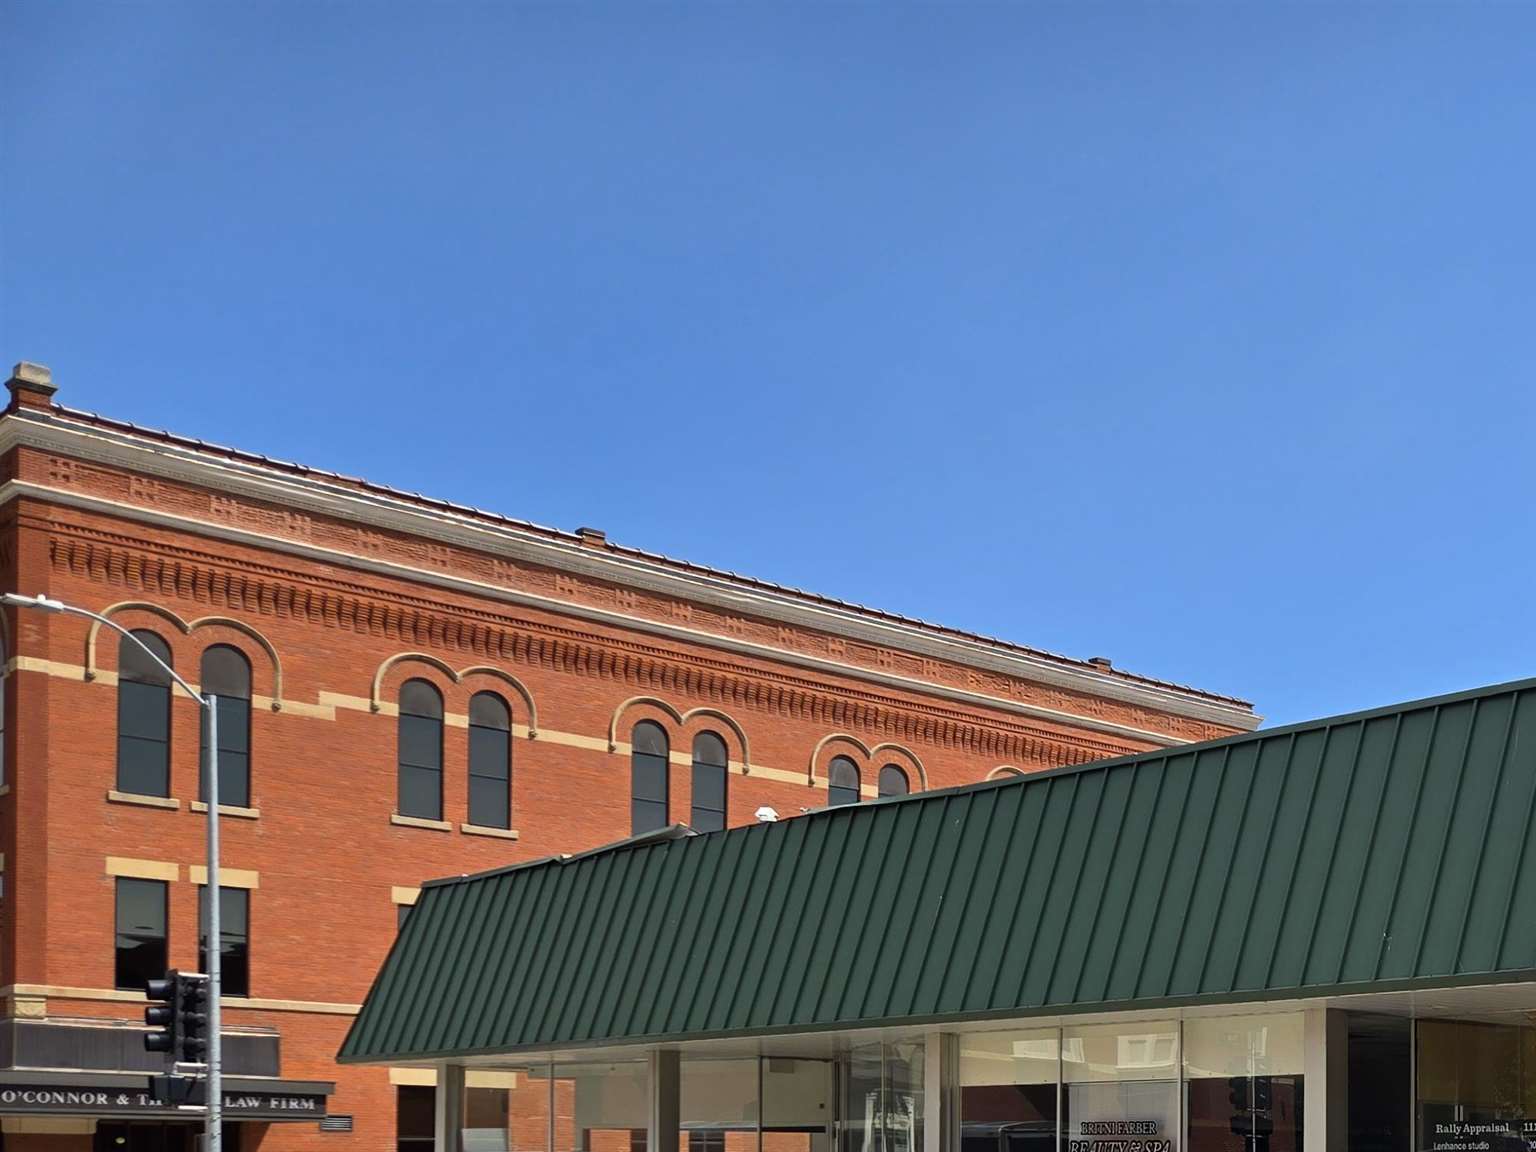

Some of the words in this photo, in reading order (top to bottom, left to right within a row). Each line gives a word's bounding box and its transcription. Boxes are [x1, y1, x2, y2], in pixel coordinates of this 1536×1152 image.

[1, 1090, 108, 1105] O'CONNOR
[116, 1094, 129, 1105] &
[224, 1096, 261, 1108] LAW
[270, 1097, 316, 1110] FIRM
[1117, 1121, 1157, 1135] FARBER
[1436, 1123, 1462, 1135] Rally
[1463, 1123, 1509, 1135] Appraisal
[1468, 1141, 1490, 1151] studio
